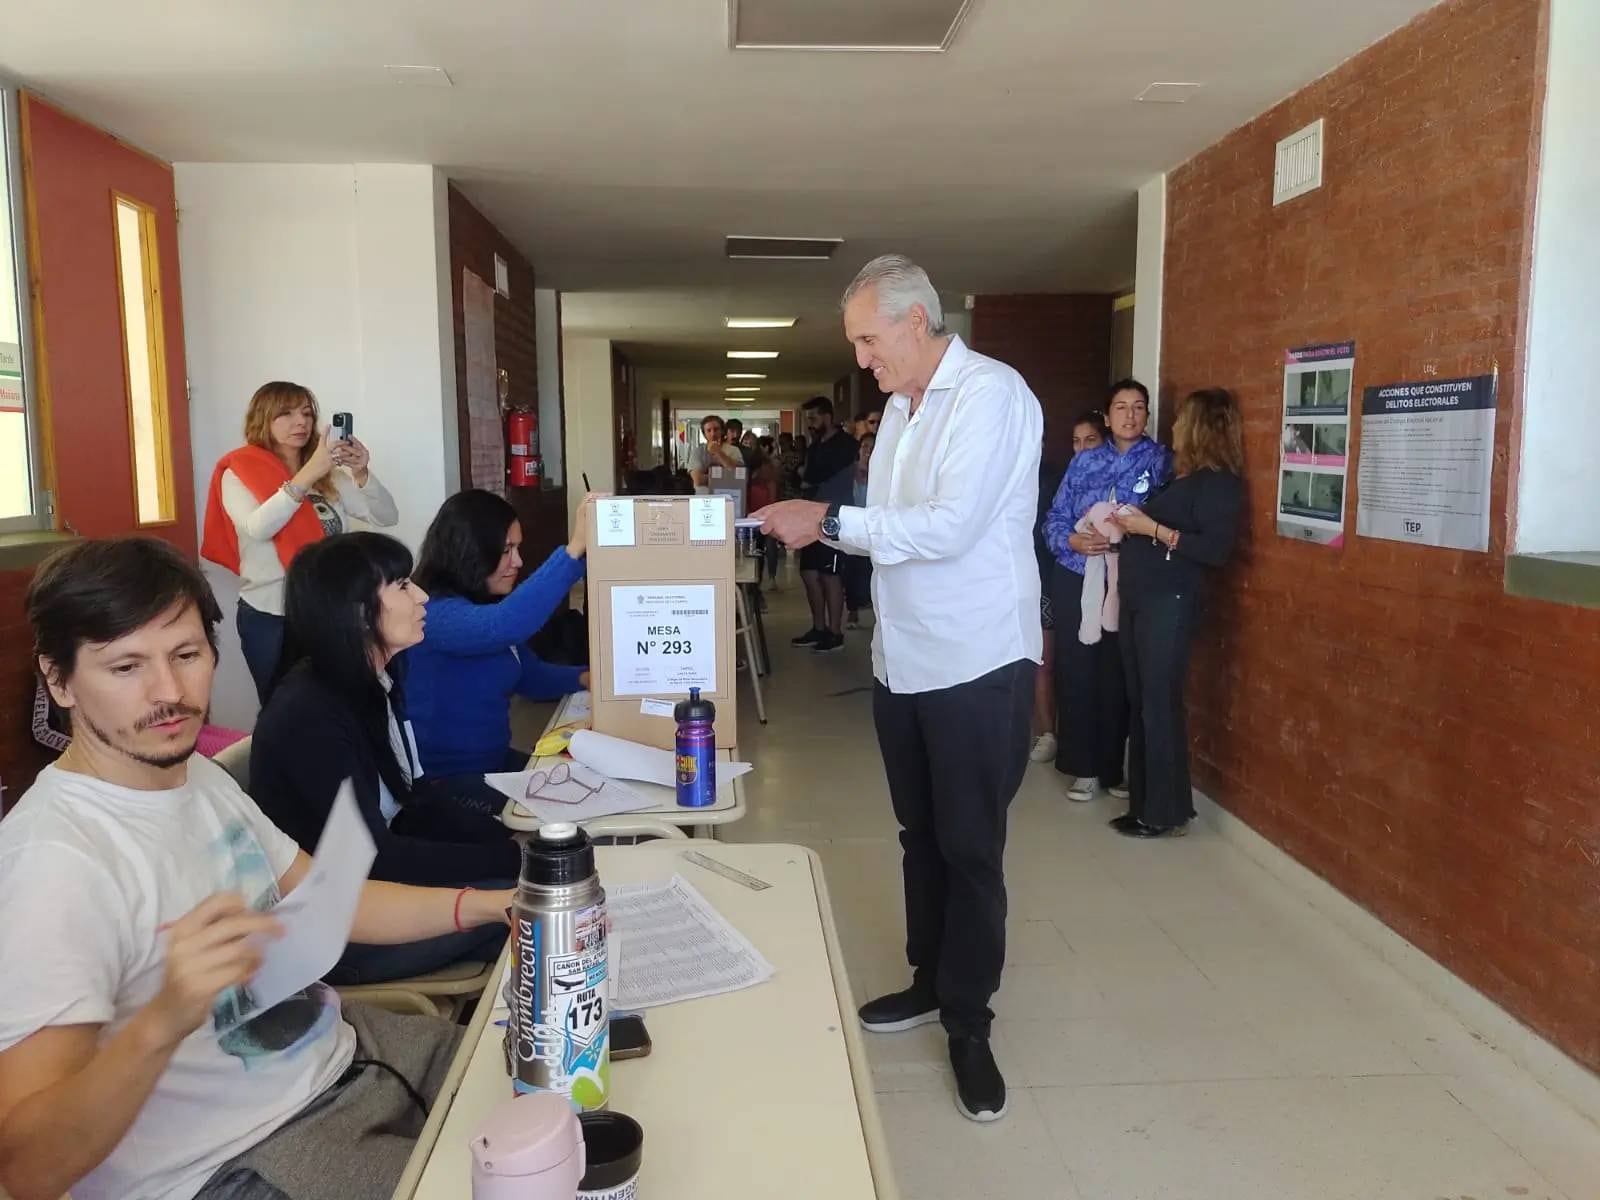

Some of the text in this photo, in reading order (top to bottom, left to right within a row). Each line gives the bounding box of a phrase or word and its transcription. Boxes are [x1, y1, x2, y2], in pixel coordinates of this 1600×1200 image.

[1378, 381, 1472, 398] ACCIONES QUE CONSTITUYEN
[1385, 396, 1459, 409] DELITOS ELECTORALES
[1405, 521, 1421, 533] TEP
[647, 625, 681, 636] MESA
[662, 640, 692, 655] 293
[513, 918, 535, 1062] Cumbrecita
[576, 987, 596, 1004] RUTA
[568, 997, 603, 1030] 173
